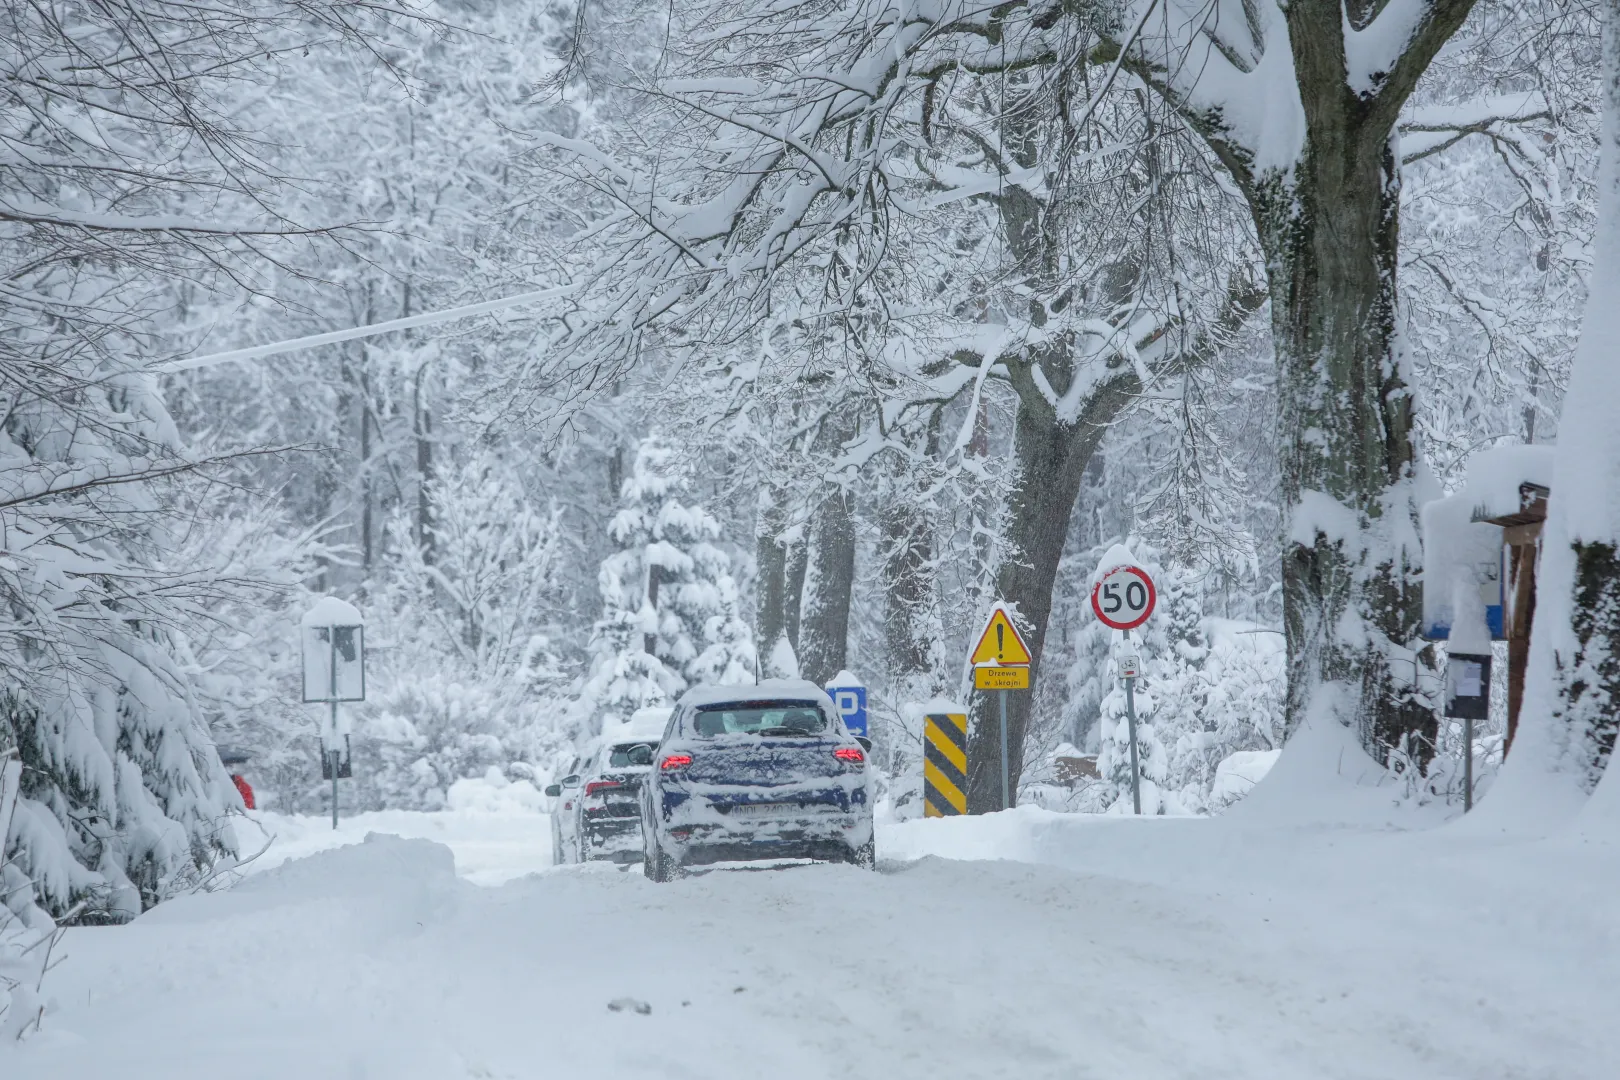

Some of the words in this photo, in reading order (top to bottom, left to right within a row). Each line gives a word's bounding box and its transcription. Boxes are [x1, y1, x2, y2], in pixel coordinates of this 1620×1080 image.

[1103, 581, 1146, 613] 50
[988, 669, 1017, 677] Drzewa
[995, 679, 1021, 687] skrajni
[836, 691, 858, 715] P
